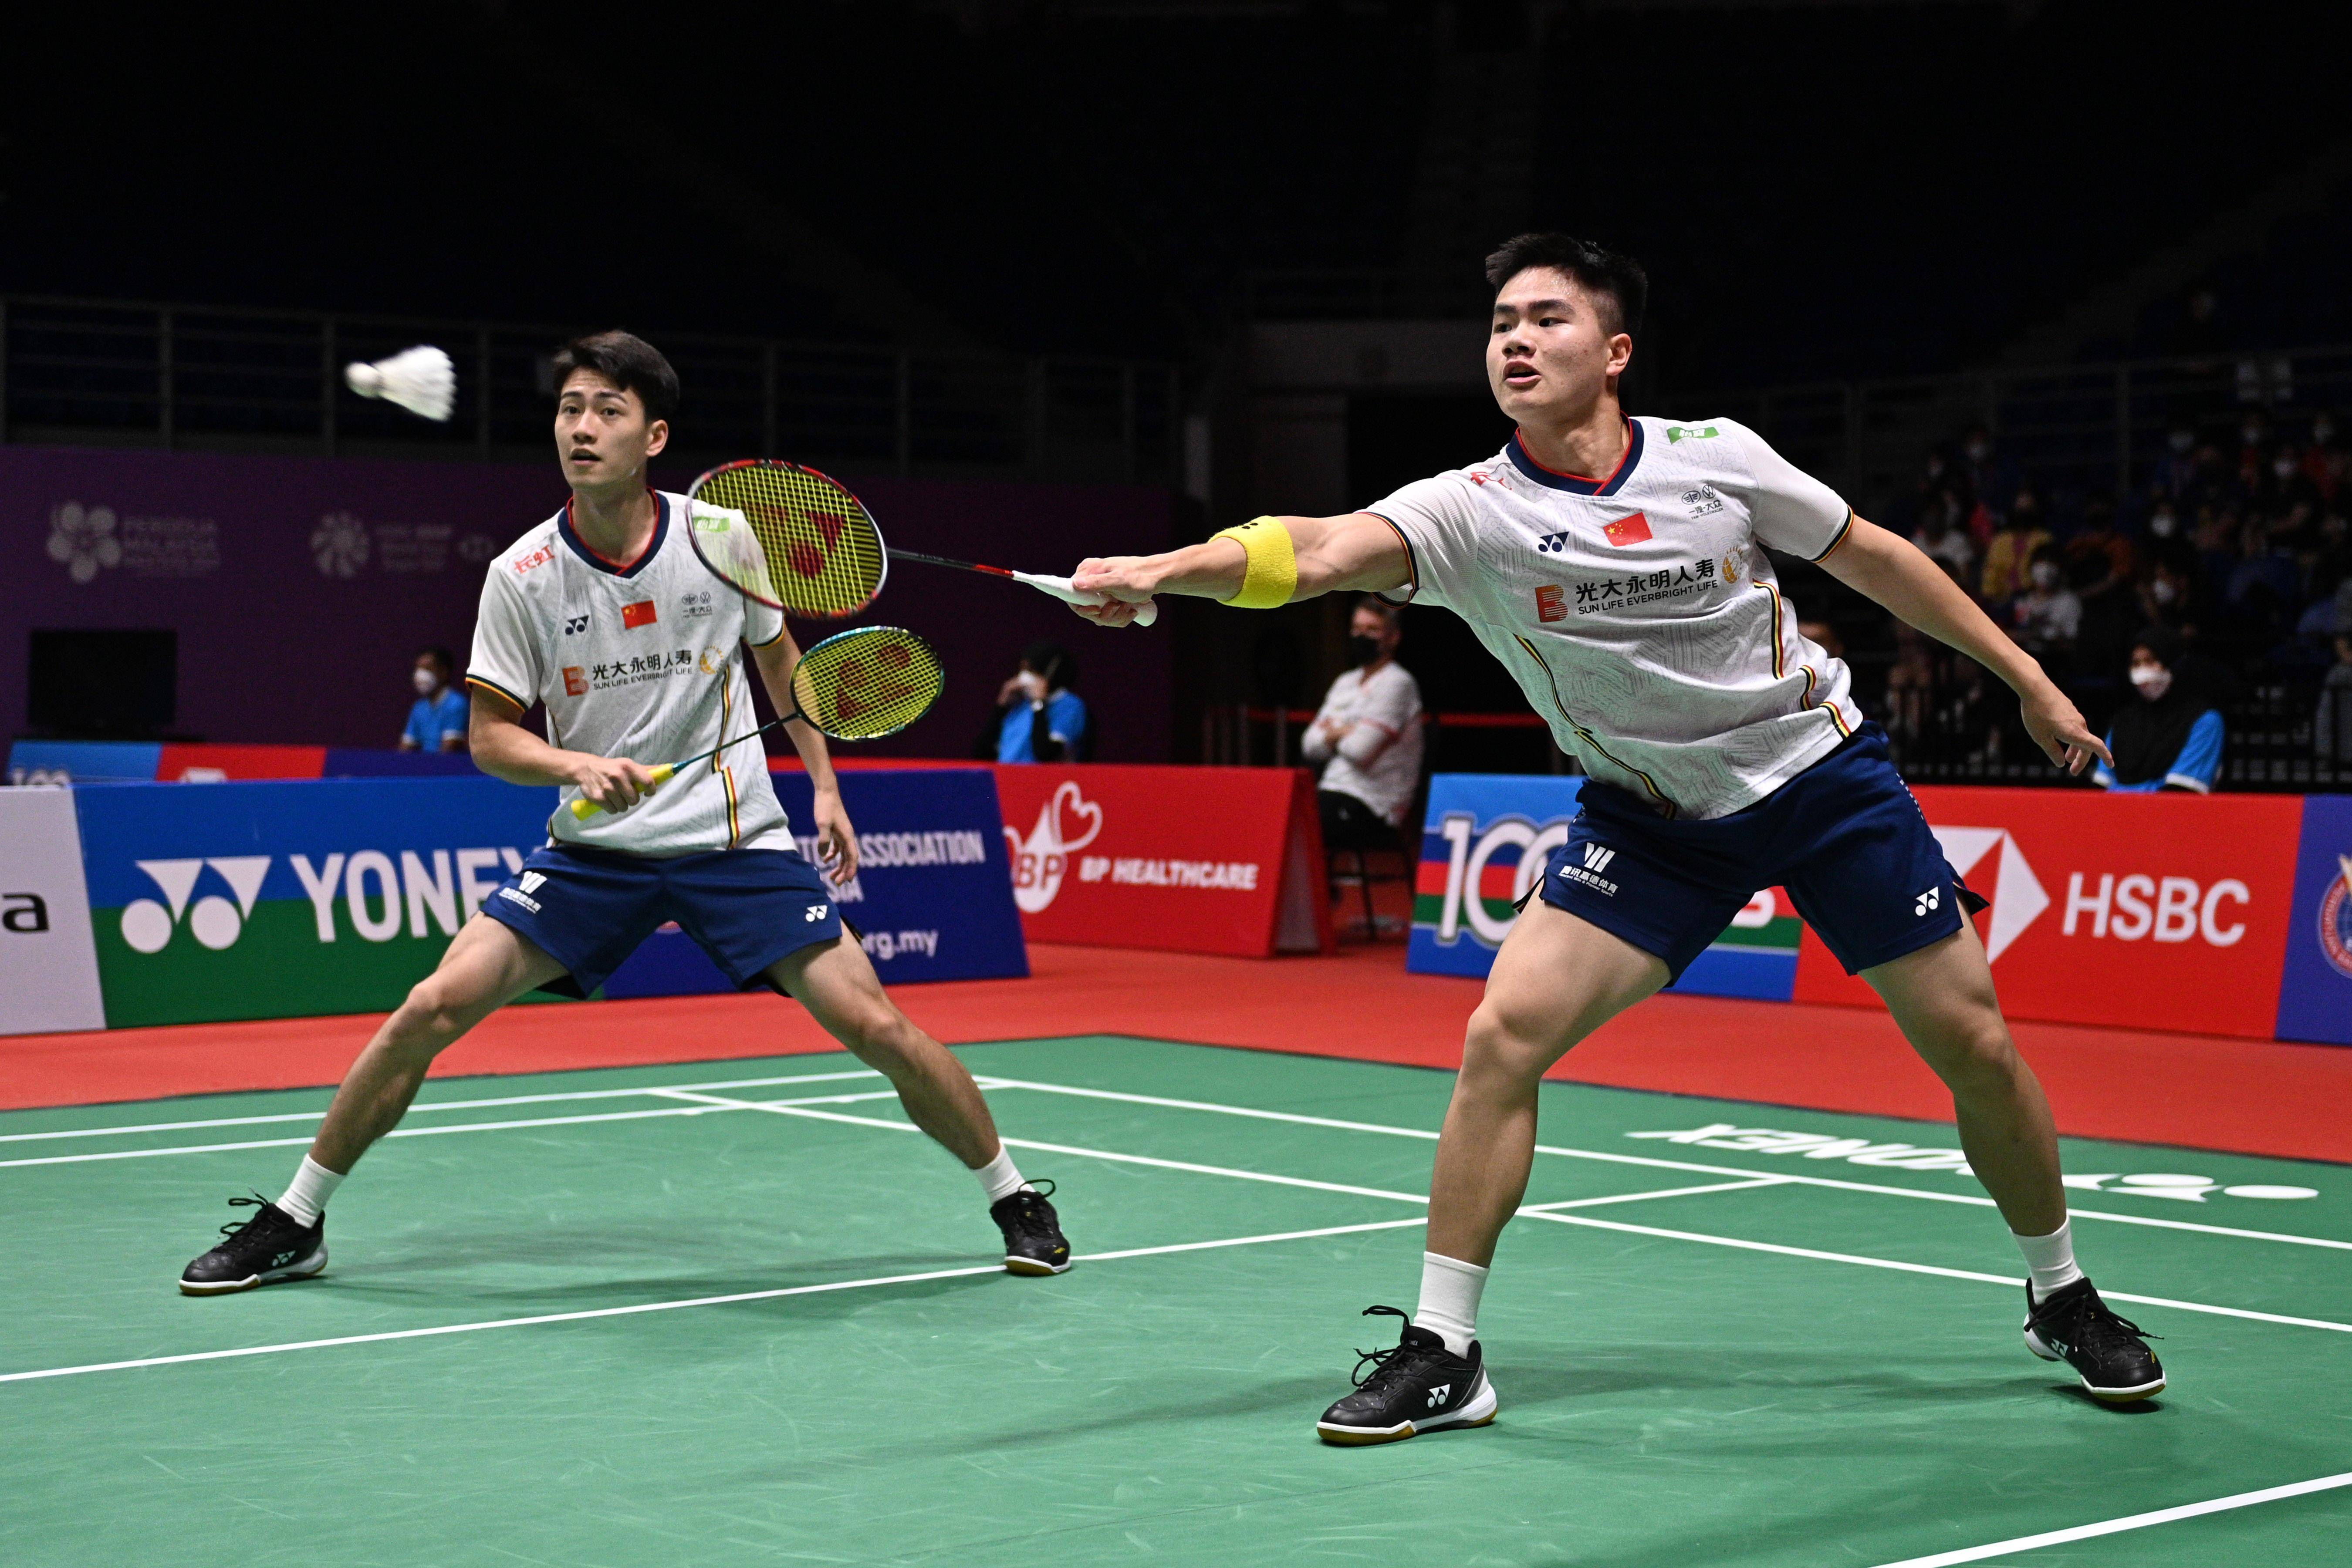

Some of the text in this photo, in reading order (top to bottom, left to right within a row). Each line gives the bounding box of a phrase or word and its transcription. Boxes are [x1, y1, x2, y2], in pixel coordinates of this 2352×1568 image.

[1576, 558, 1715, 604] 光大永明人寿
[1578, 580, 1718, 615] SUN LIFE EVERBRIGHT LIFE
[593, 649, 693, 681] 光大永明人寿
[594, 681, 610, 690] SUN
[612, 678, 629, 687] LIFE
[1112, 857, 1259, 890] HEALTHCARE
[1601, 889, 1613, 897] Sports
[2062, 872, 2250, 948] HSBC
[1625, 1123, 1975, 1176] ONEX
